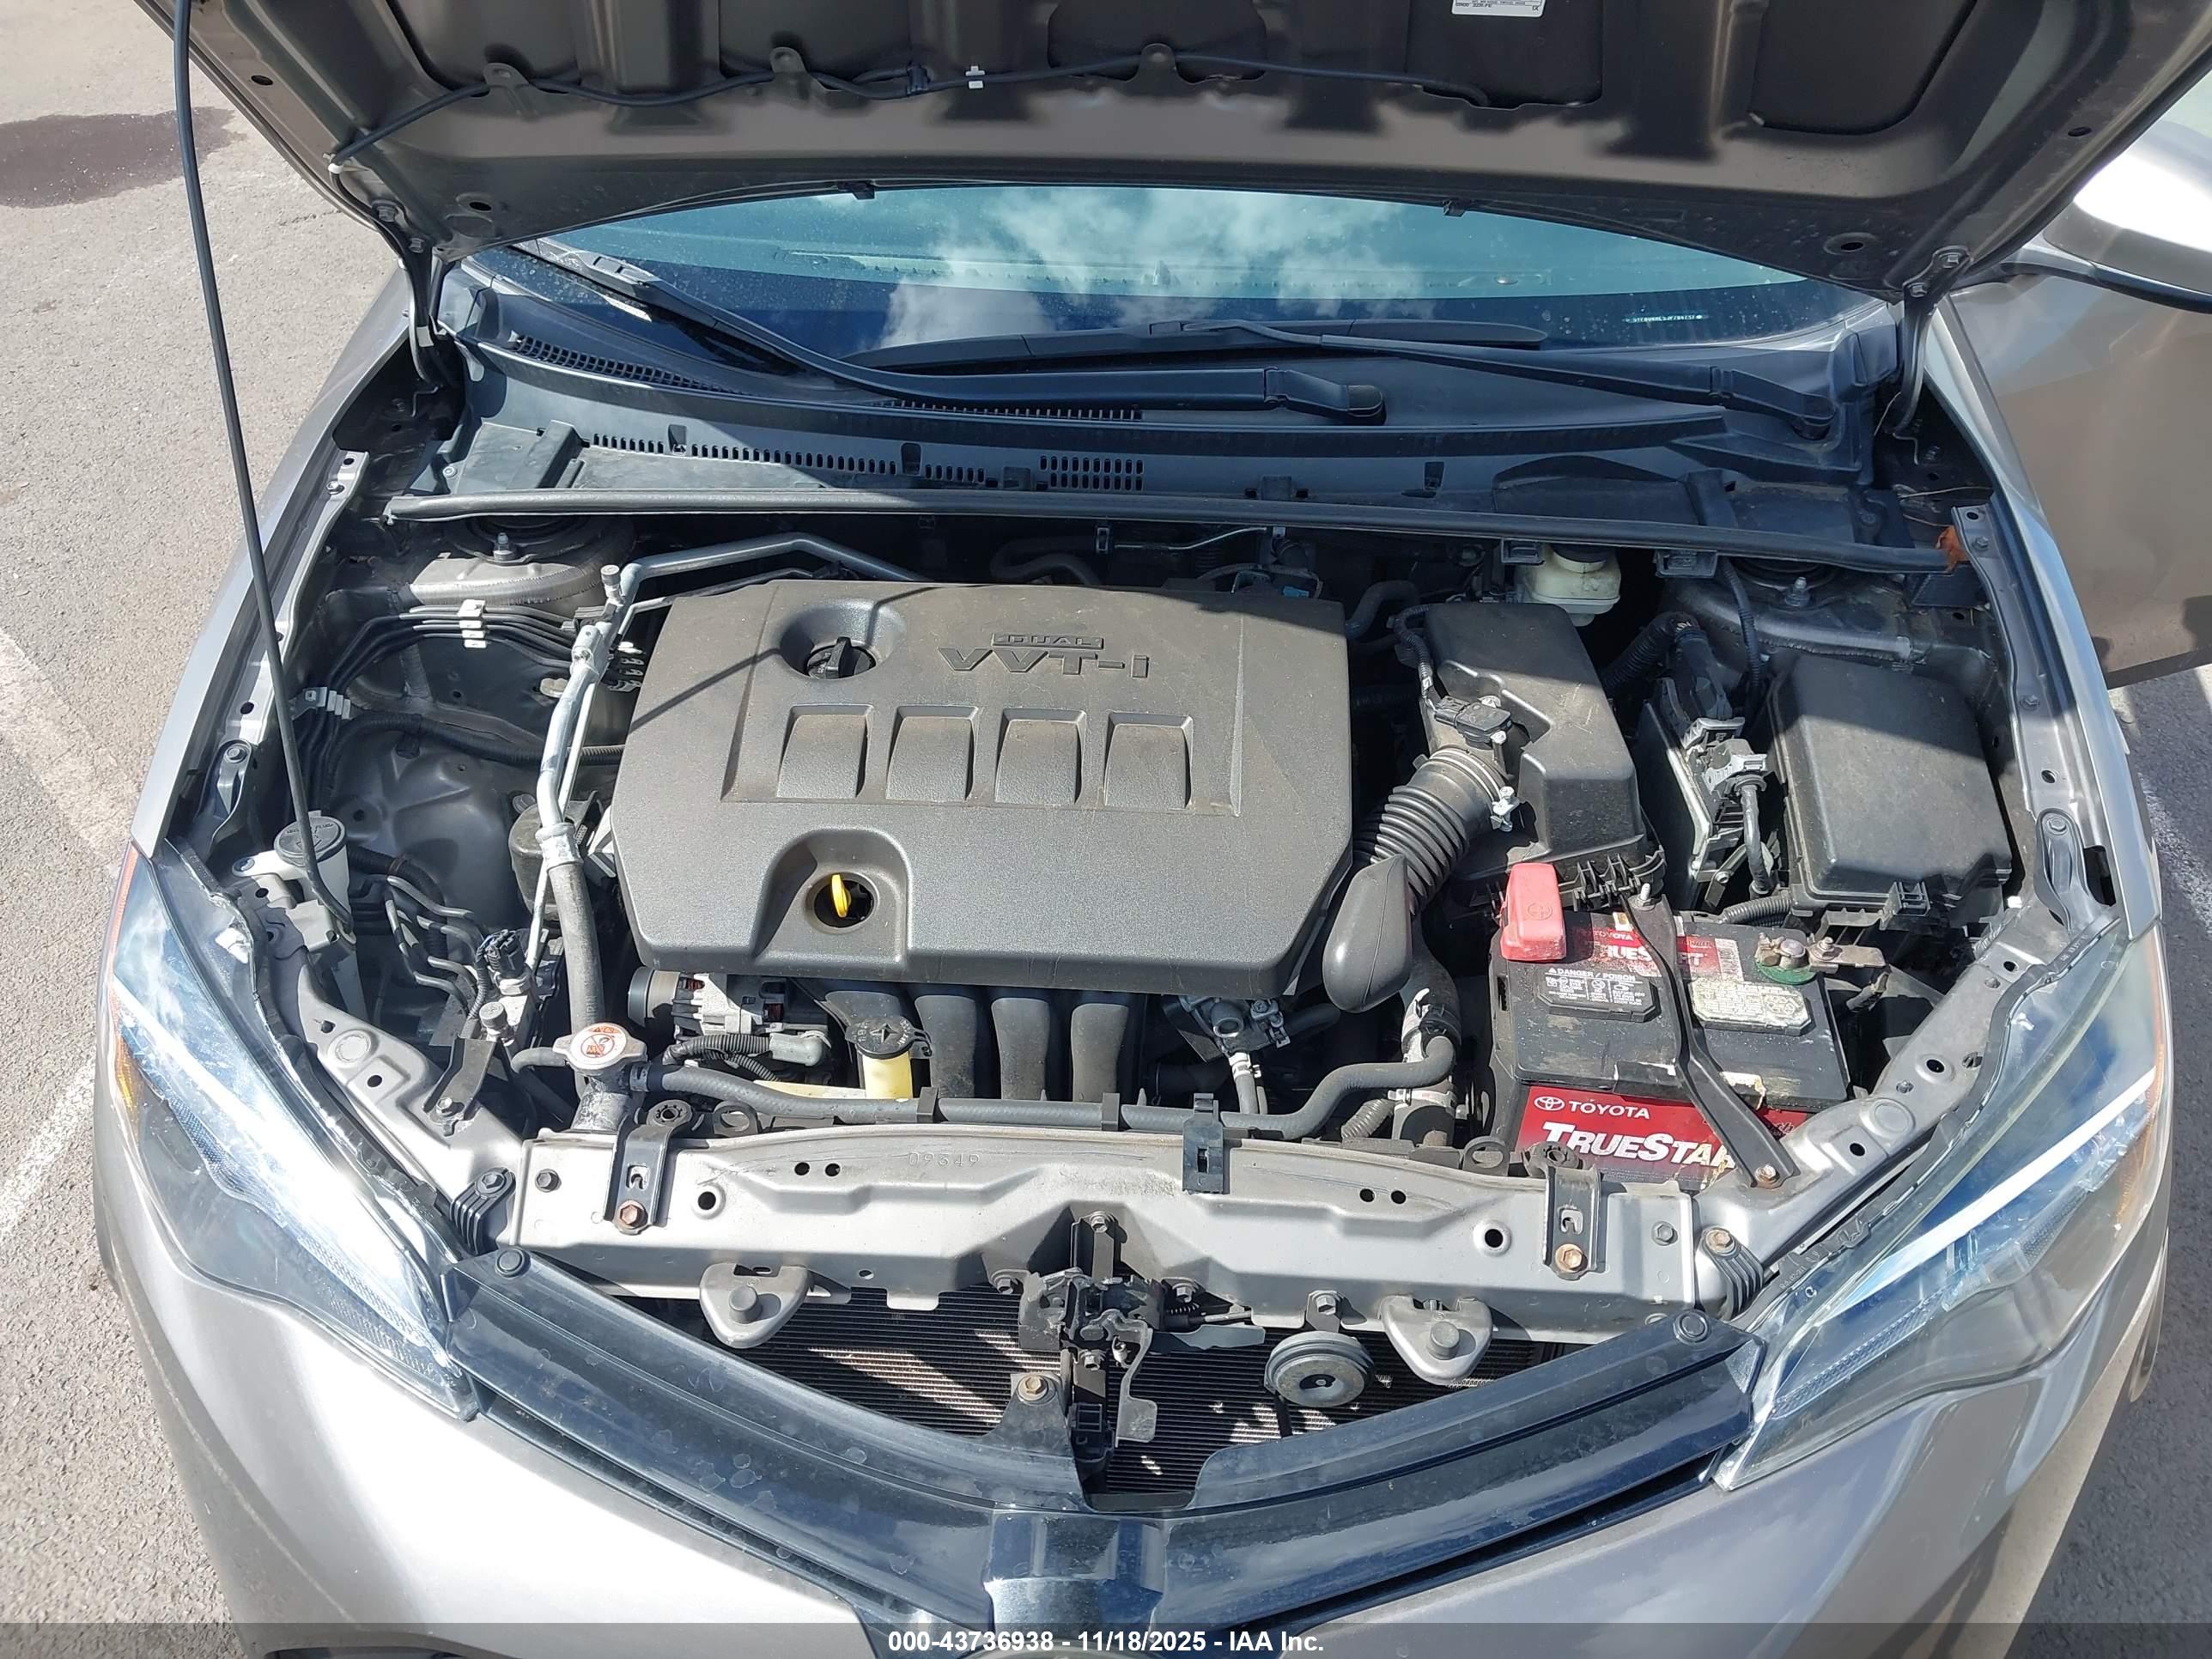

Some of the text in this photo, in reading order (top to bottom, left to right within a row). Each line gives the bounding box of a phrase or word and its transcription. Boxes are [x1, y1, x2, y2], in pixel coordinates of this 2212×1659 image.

[1007, 634, 1093, 647] DUAL
[1557, 968, 1595, 978] DANGER
[1602, 972, 1637, 981] POISON
[1569, 1099, 1650, 1120] TOYOTA
